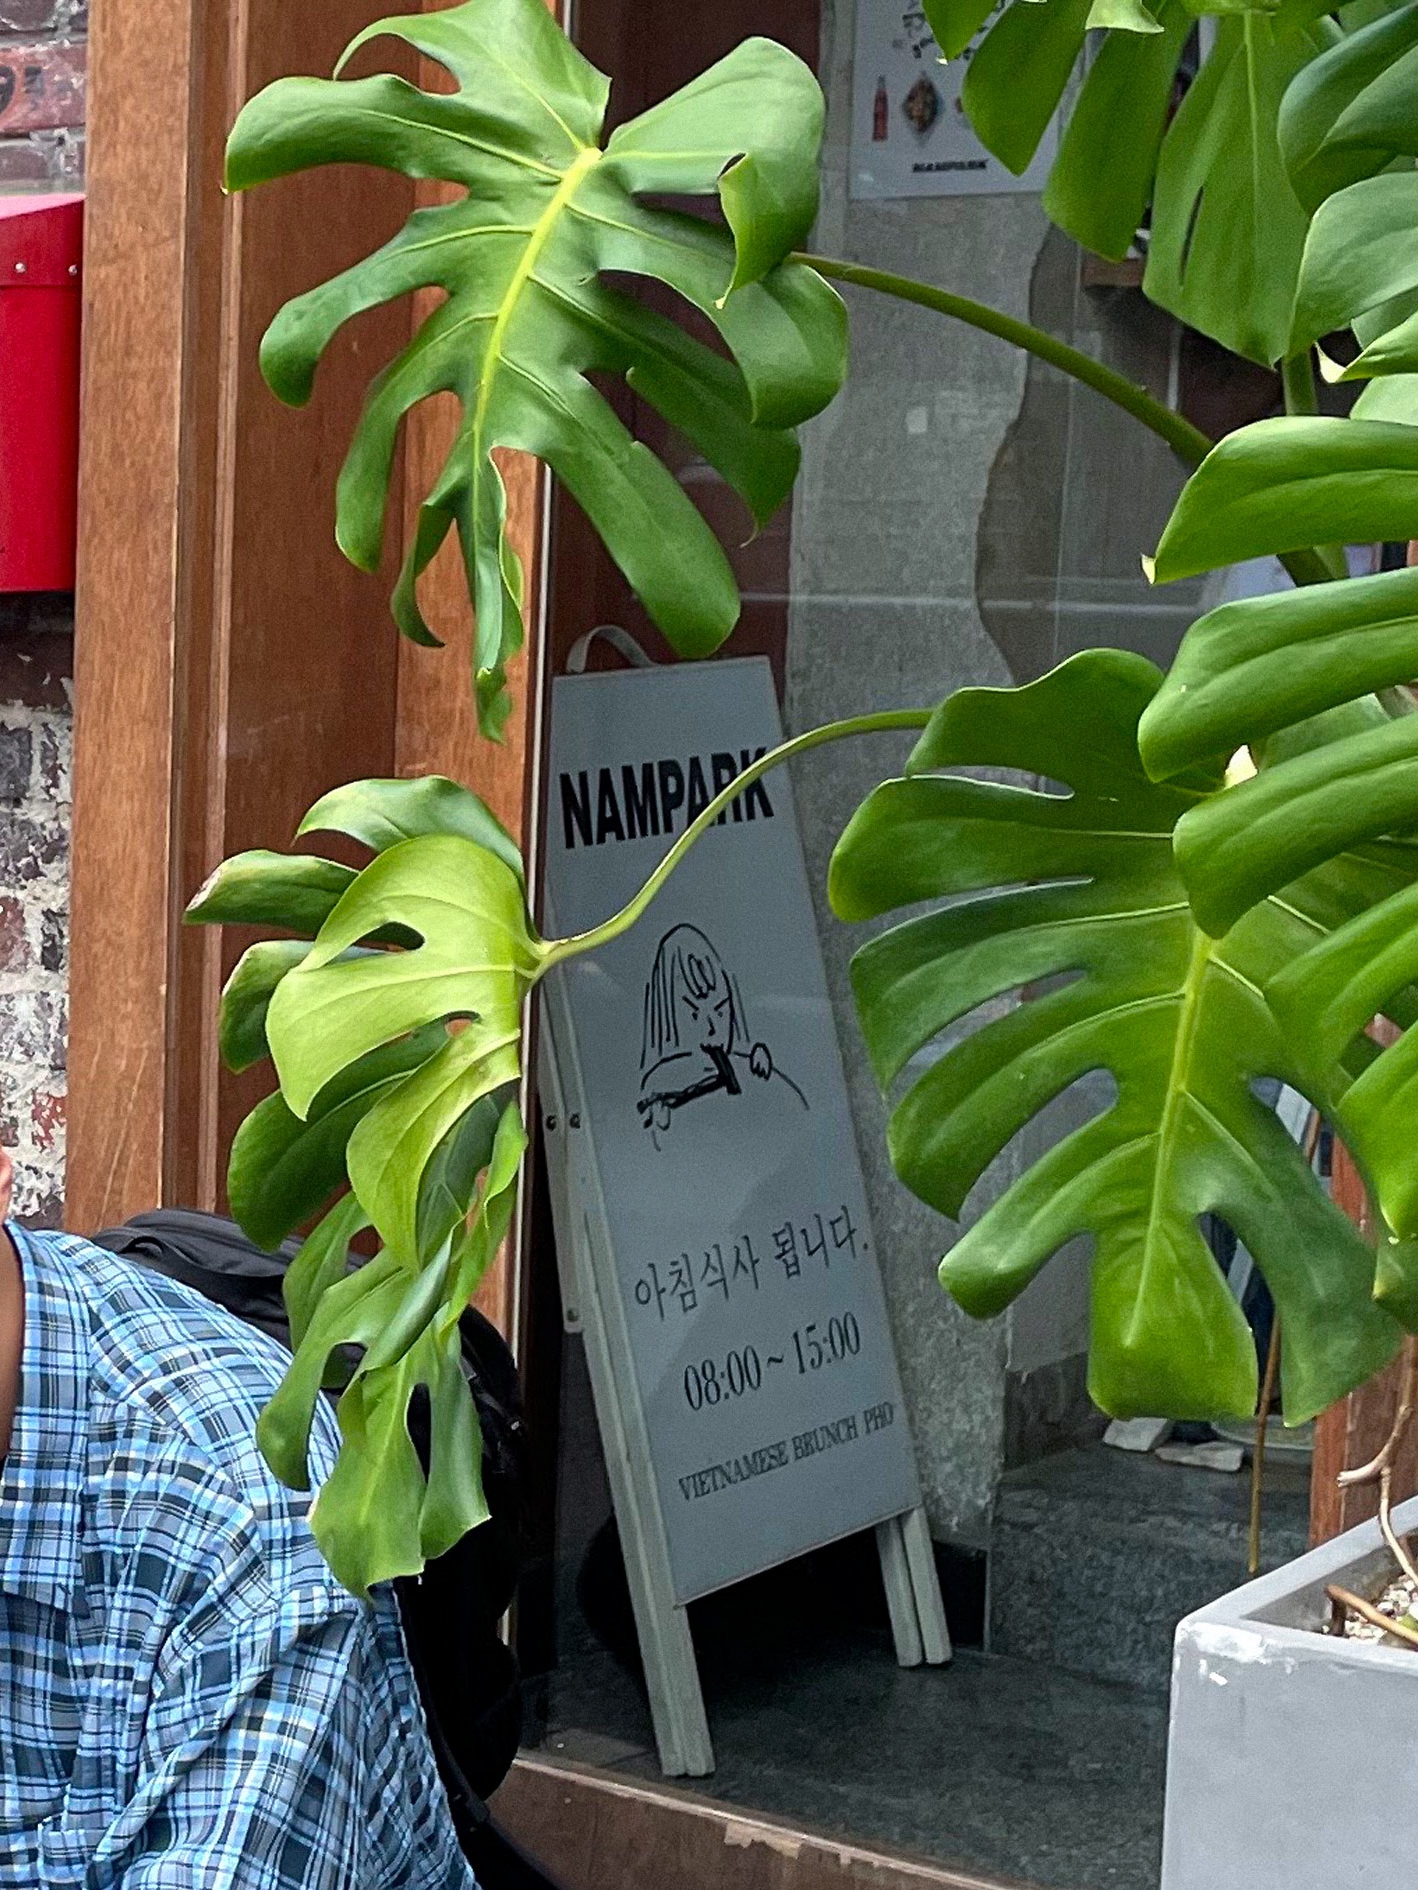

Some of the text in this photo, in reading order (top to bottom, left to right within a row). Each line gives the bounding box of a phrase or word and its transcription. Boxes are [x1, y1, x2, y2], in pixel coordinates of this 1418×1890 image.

[559, 747, 775, 849] NAMPARK
[634, 1234, 761, 1322] 아침식사
[684, 1345, 762, 1411] 08:00
[792, 1311, 861, 1375] 15:00
[677, 1401, 895, 1501] VIETNAMESE BRUNCH PHO
